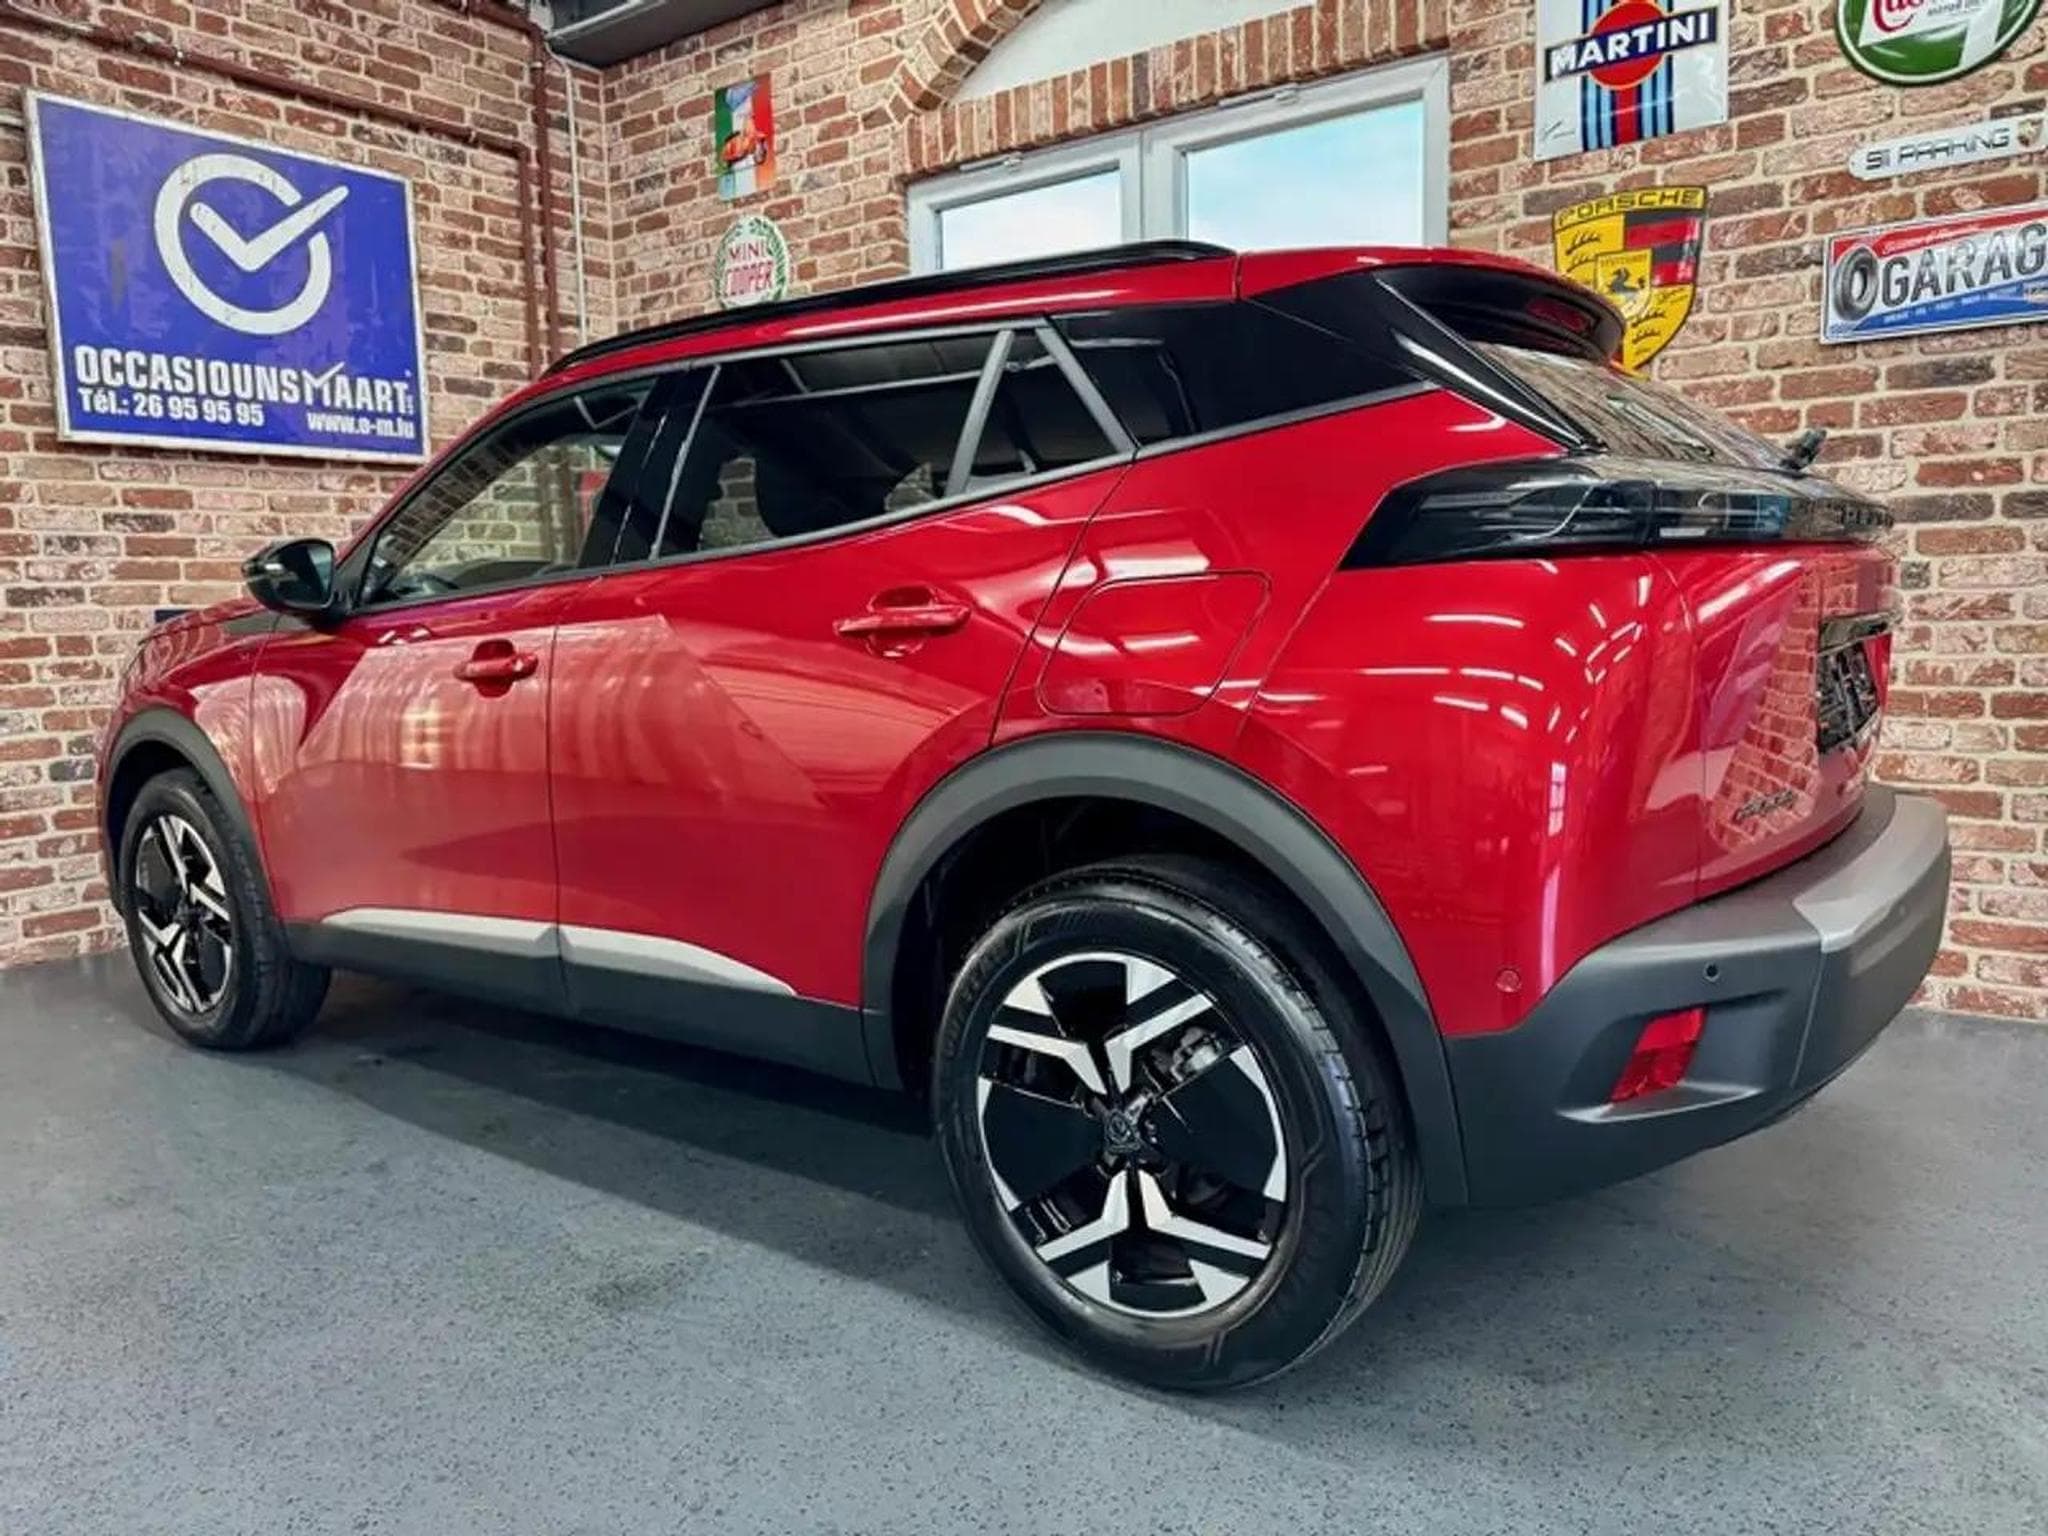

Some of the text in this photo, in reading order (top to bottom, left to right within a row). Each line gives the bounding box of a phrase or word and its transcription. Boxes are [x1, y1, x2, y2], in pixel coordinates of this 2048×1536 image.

[1550, 12, 1709, 78] MARTINI
[1558, 190, 1700, 226] PORSCHE
[132, 391, 164, 419] 26
[168, 395, 199, 421] 95
[202, 398, 233, 425] 95
[235, 401, 265, 427] 95
